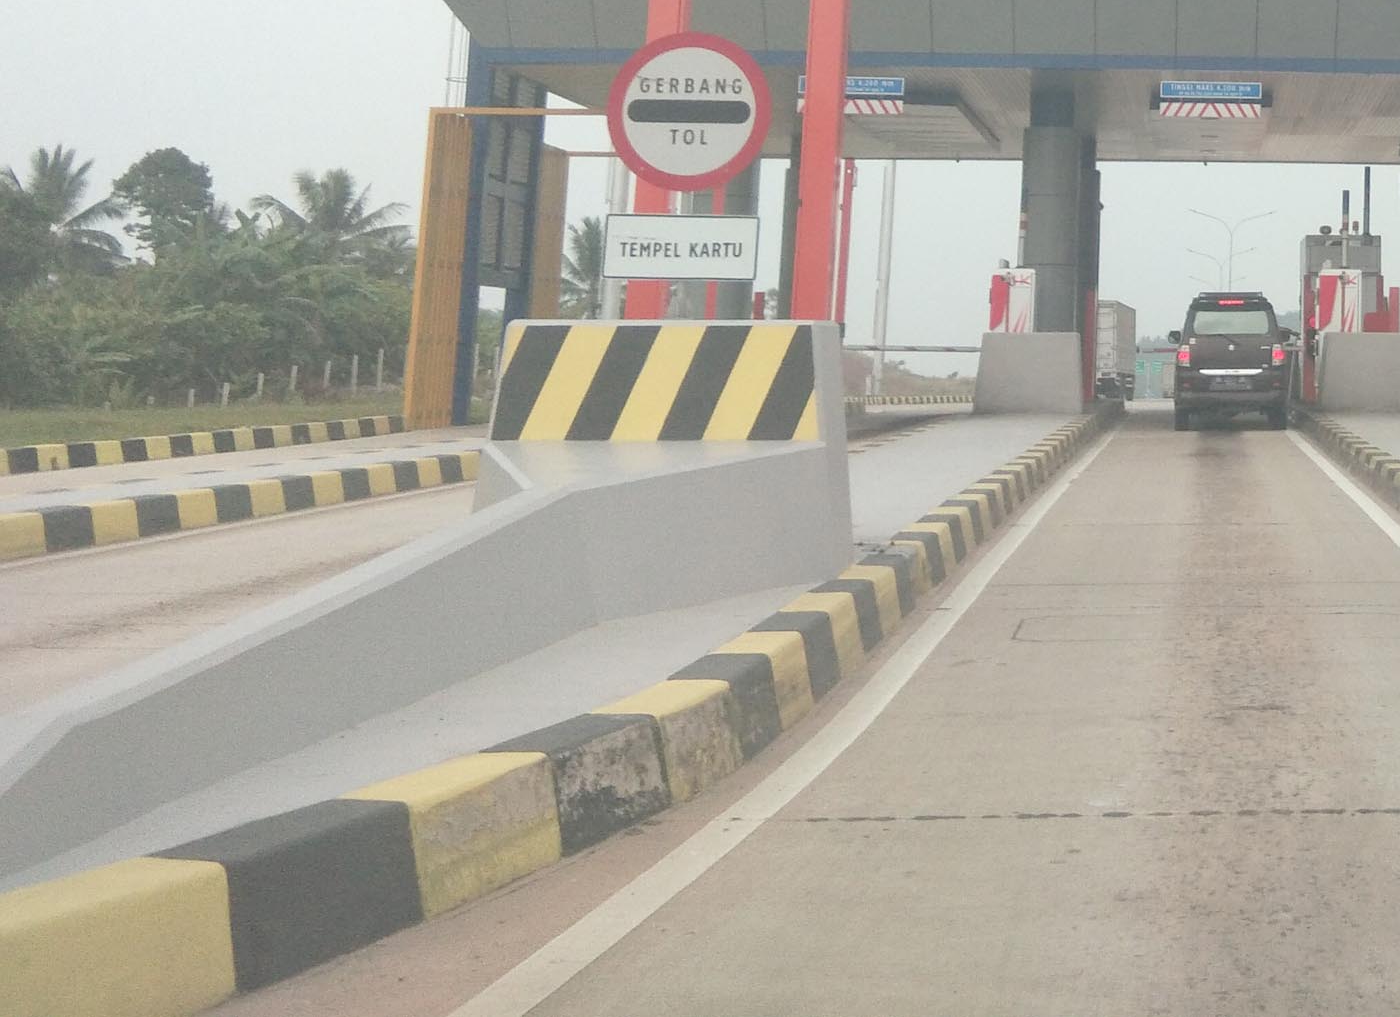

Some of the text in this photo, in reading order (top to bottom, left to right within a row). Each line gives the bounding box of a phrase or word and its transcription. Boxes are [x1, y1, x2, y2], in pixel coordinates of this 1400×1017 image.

[640, 78, 743, 95] GERBANG
[670, 129, 708, 145] TOL
[620, 242, 743, 258] TEMPEL KARTU
